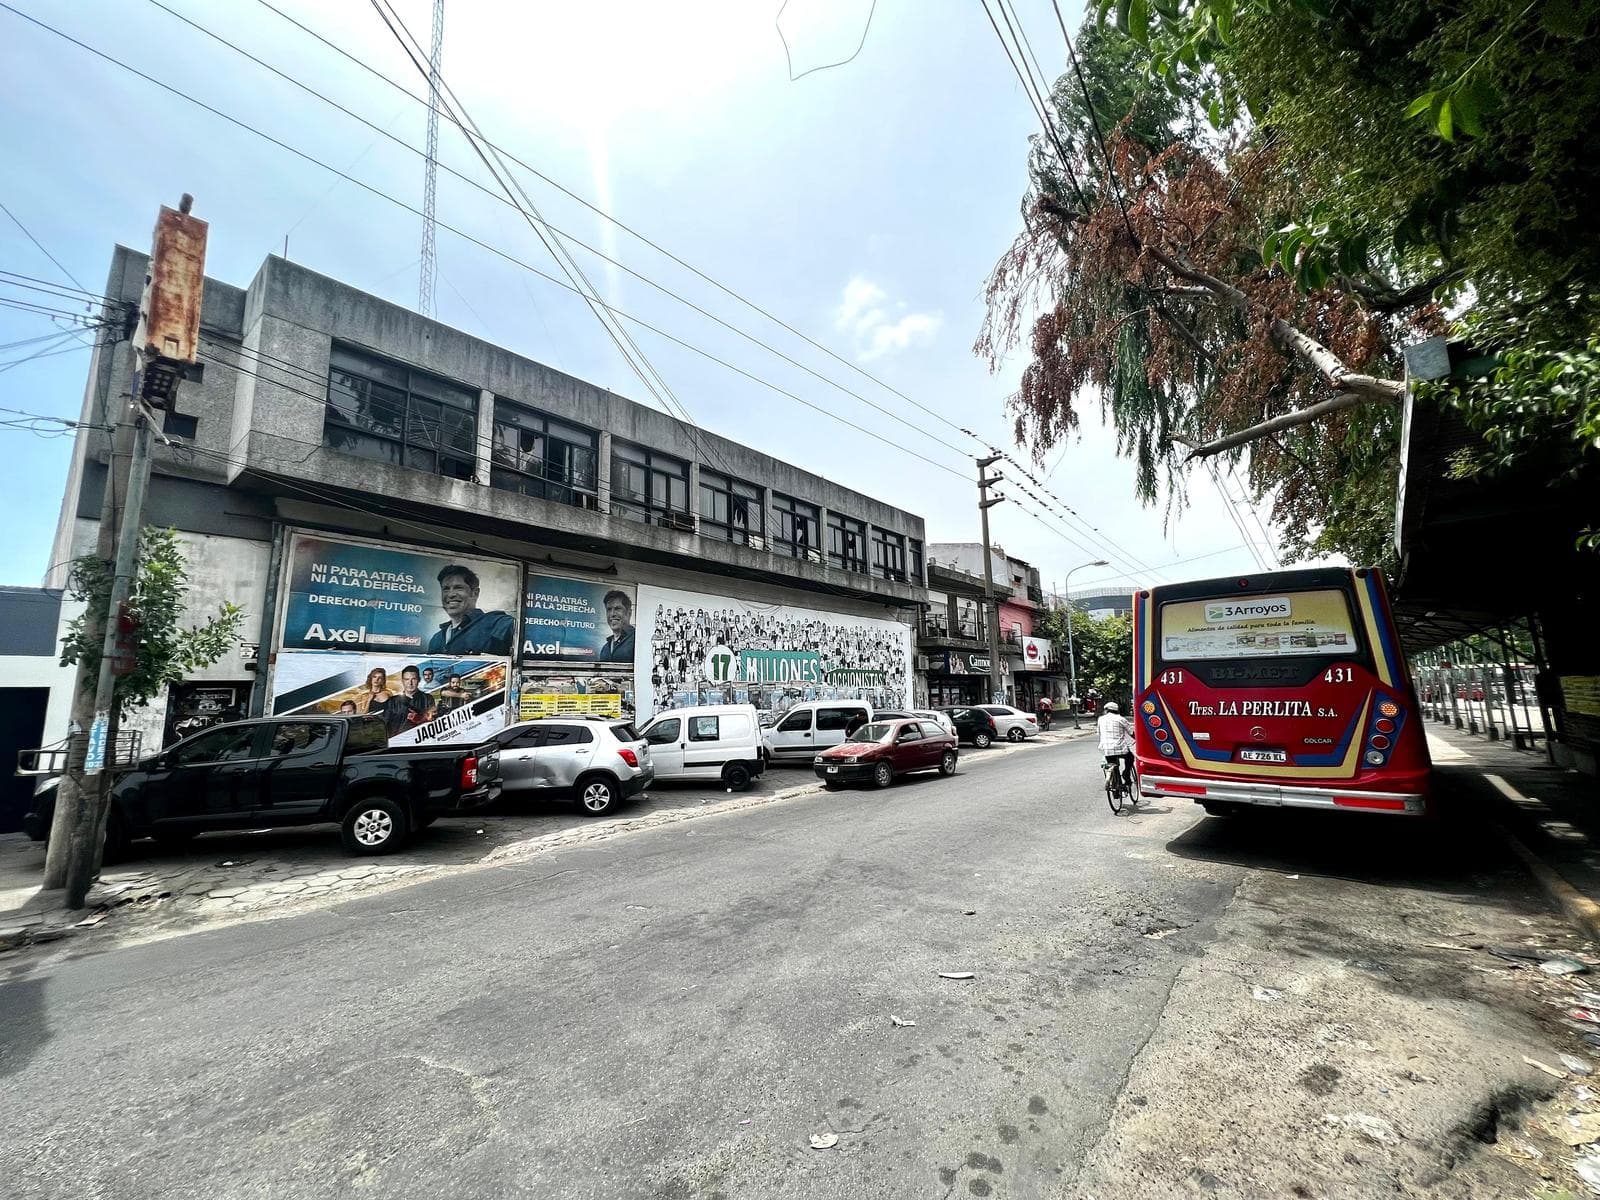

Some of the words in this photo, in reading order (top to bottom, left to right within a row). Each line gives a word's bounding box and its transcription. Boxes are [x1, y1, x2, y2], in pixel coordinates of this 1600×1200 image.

[312, 563, 328, 574] NI
[330, 566, 368, 579] PARA
[370, 571, 414, 584] ATRÁS
[310, 573, 326, 583] NI
[328, 576, 339, 585] A
[341, 577, 361, 587] LA
[363, 579, 425, 594] DERECHA
[308, 594, 367, 608] DERECHO
[378, 601, 422, 613] FUTURO
[535, 594, 559, 603] PARA
[560, 597, 588, 606] ATRÁS
[543, 602, 555, 610] LA
[556, 604, 596, 614] DERECHA
[304, 623, 366, 643] Axel
[1249, 623, 1265, 631] para
[523, 640, 560, 655] Axel
[710, 654, 731, 681] 17
[746, 657, 818, 685] MILLONES
[826, 659, 836, 671] DE
[832, 671, 883, 688] ACCIONISTAS
[1160, 671, 1184, 685] 431
[1324, 667, 1354, 683] 431
[1218, 701, 1238, 716] LA
[1241, 701, 1313, 717] PERLITA
[1317, 707, 1338, 718] S.A.
[1255, 752, 1271, 760] 726
